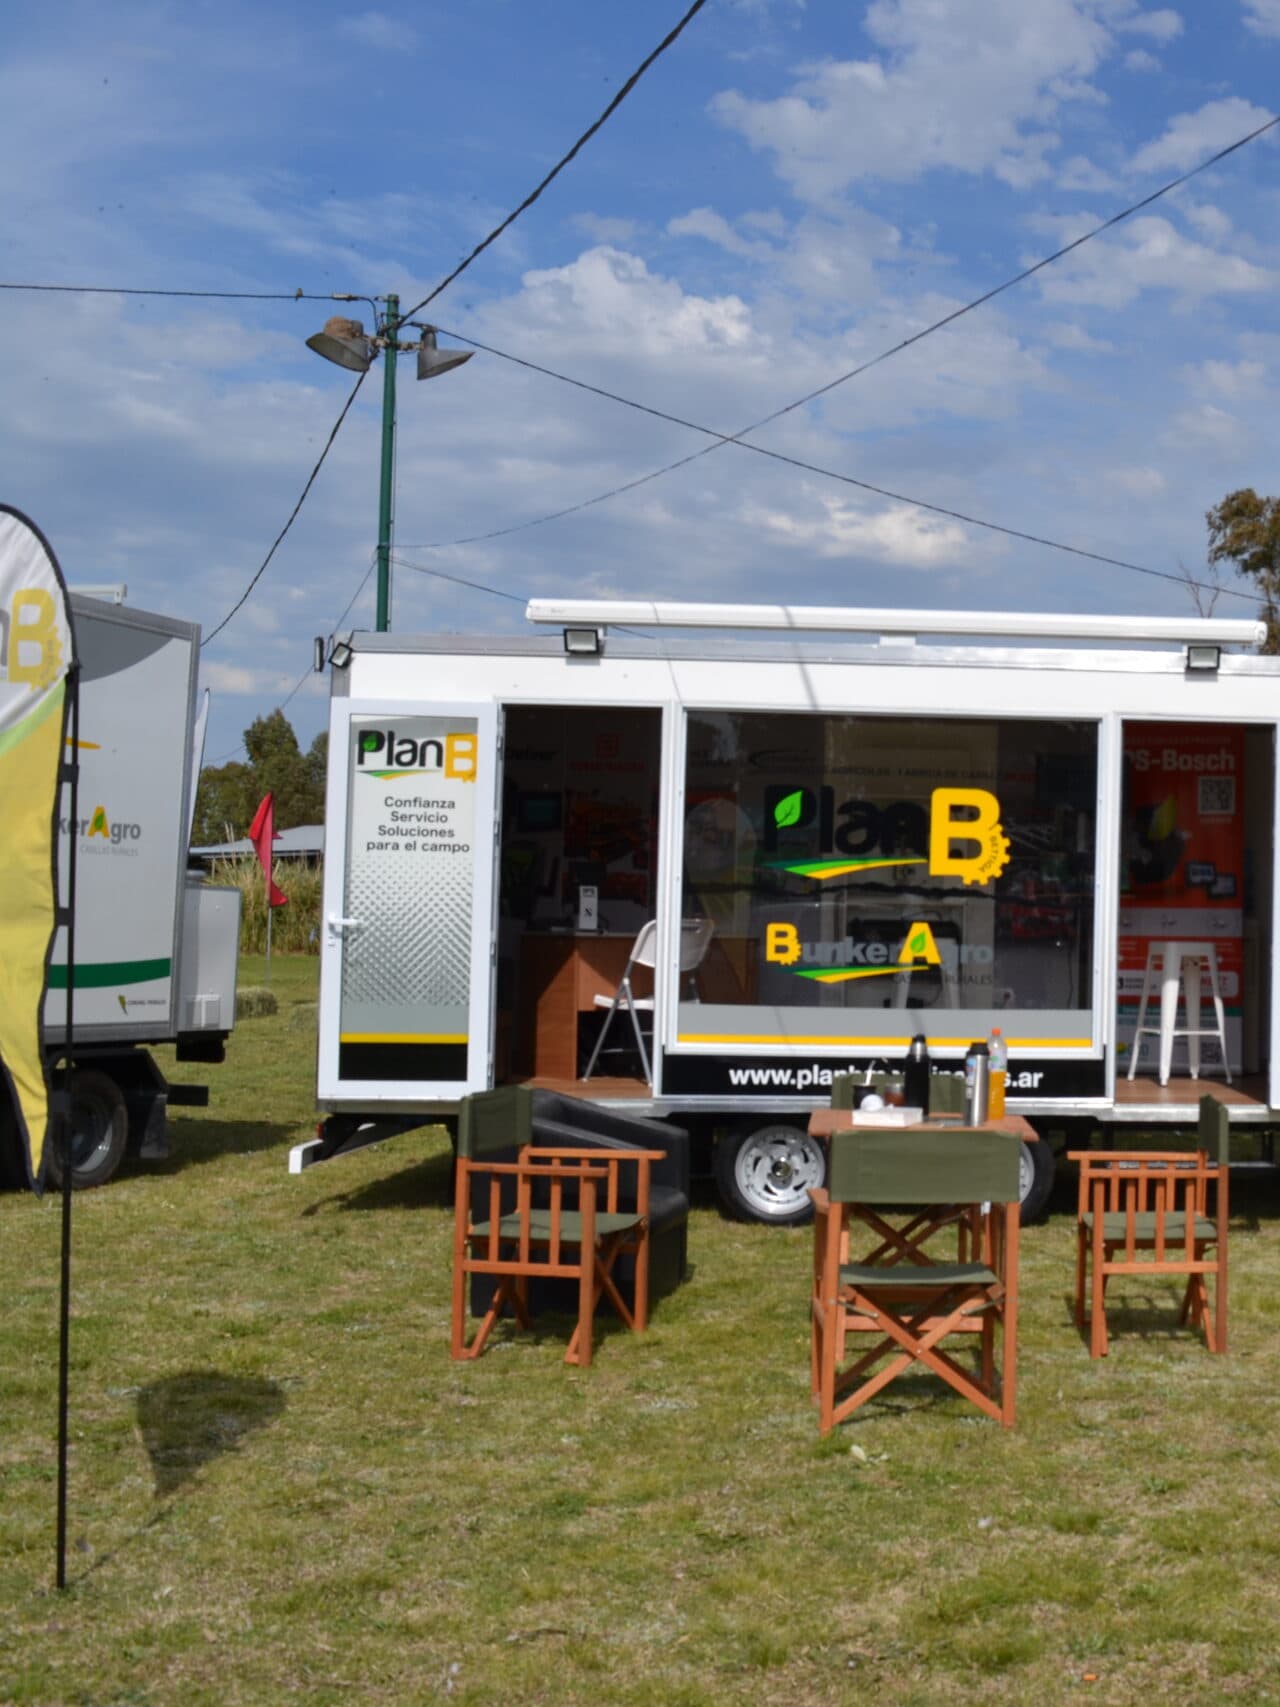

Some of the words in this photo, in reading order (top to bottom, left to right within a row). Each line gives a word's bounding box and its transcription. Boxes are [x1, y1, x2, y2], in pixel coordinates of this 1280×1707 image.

[384, 796, 456, 810] Confianza
[391, 811, 449, 824] Servicio
[378, 825, 456, 839] Soluciones
[366, 841, 400, 853] para
[404, 841, 417, 852] el
[421, 843, 471, 855] campo
